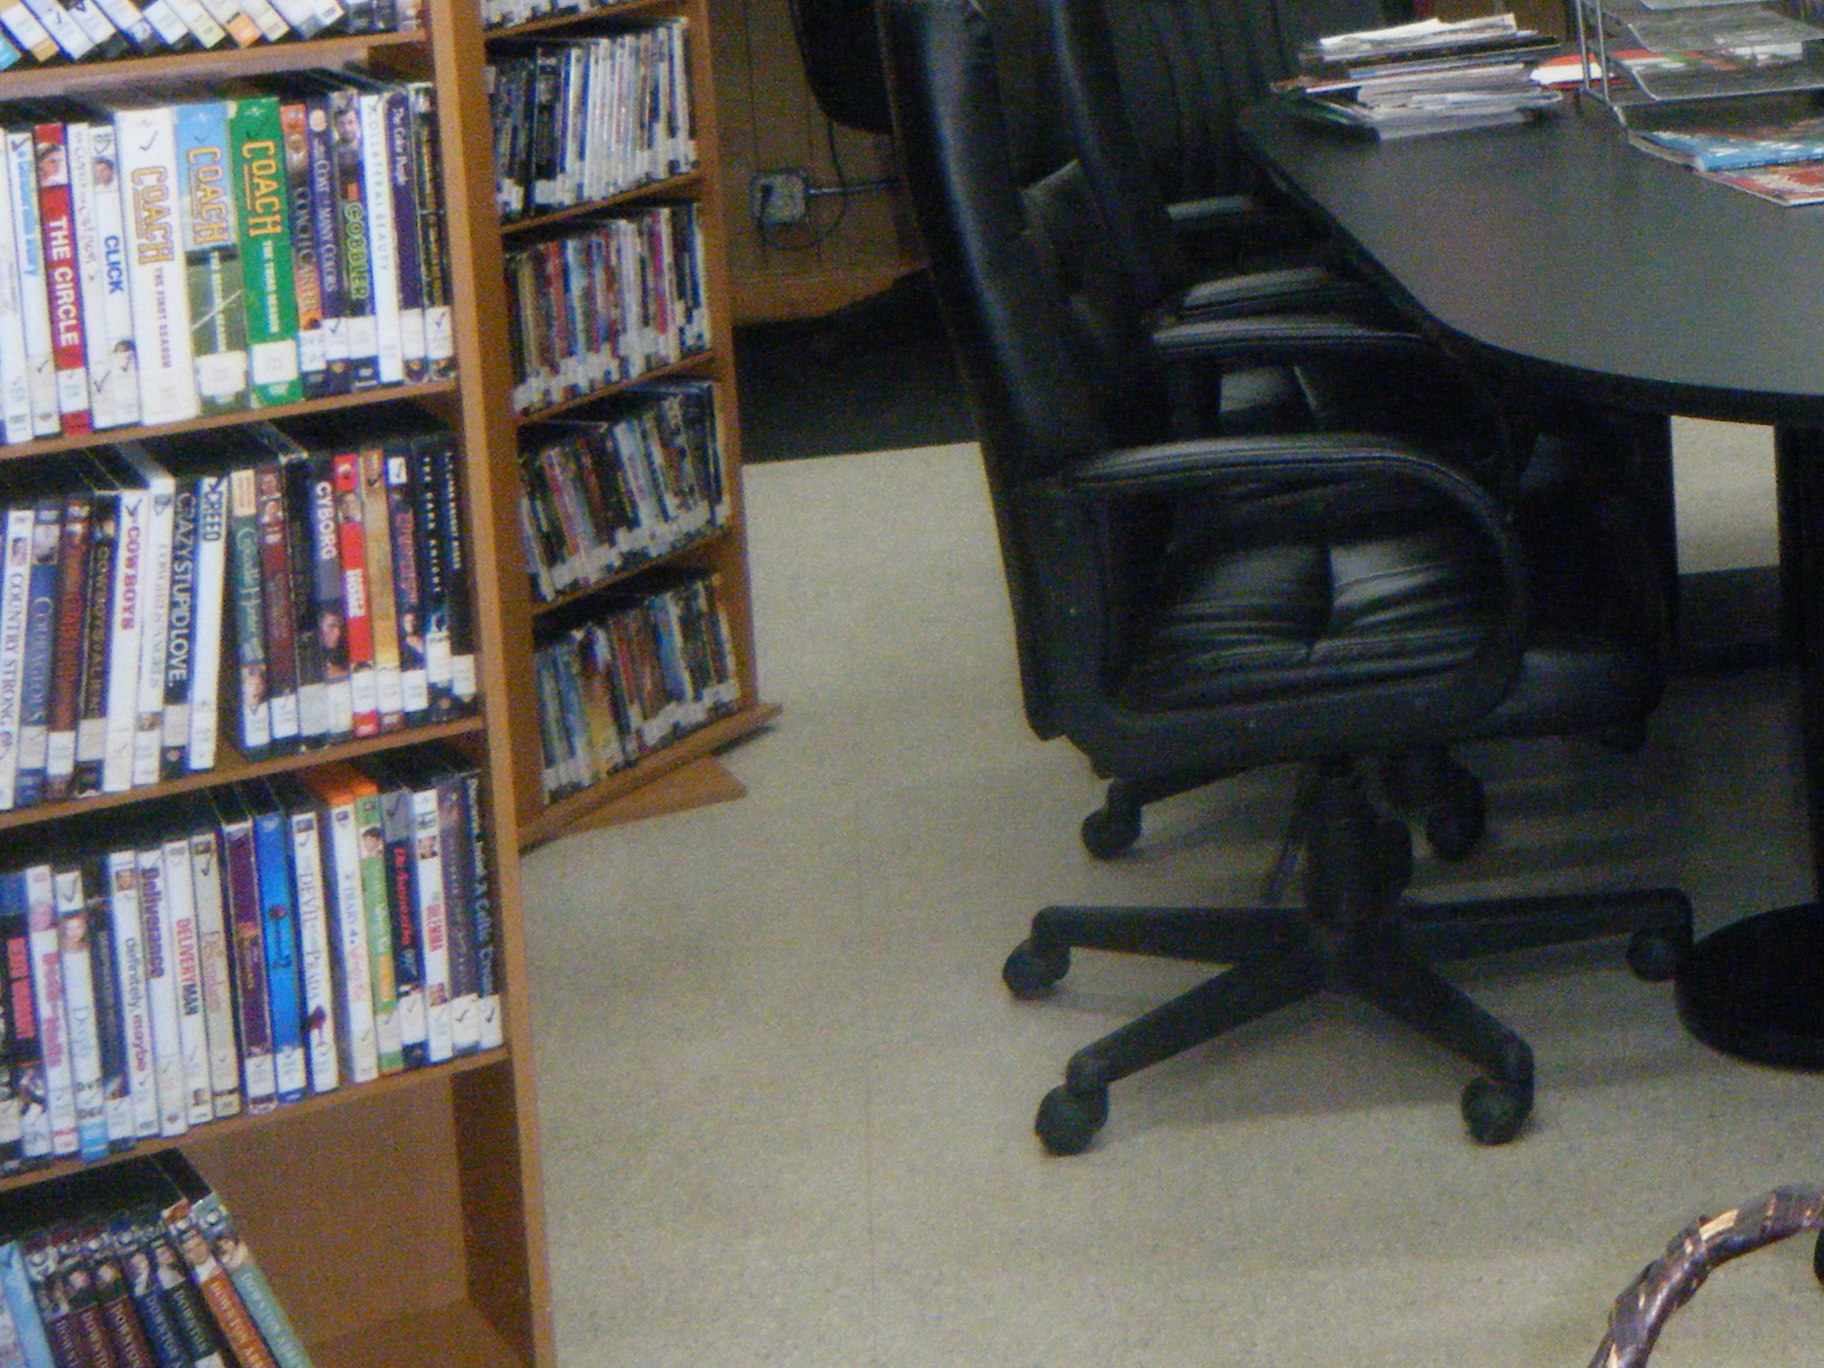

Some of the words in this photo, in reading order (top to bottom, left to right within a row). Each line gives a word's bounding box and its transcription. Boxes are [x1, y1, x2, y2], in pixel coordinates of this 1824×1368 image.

[131, 165, 176, 266] COACH
[186, 145, 229, 246] COACH
[50, 216, 71, 261] THE
[104, 234, 124, 294] CLICK
[242, 139, 283, 238] COACH
[267, 293, 280, 334] SEASON
[343, 201, 369, 300] COBBLER
[375, 213, 389, 270] BEAUTY
[54, 266, 79, 347] CIRCLE
[153, 266, 165, 287] THE
[156, 289, 169, 319] FIRST
[159, 323, 171, 368] SEASON
[202, 490, 222, 542] CREED
[315, 481, 338, 560] CYBORG
[425, 491, 437, 531] DARK
[119, 524, 141, 631] COWBOYS
[429, 538, 442, 593] KNIGHT
[6, 572, 23, 653] COUNTRY
[1, 658, 18, 725] STRONG
[139, 867, 167, 980] Deliverance
[175, 917, 198, 983] DELIVERY
[181, 983, 201, 1017] MAN
[130, 1013, 149, 1072] maybe
